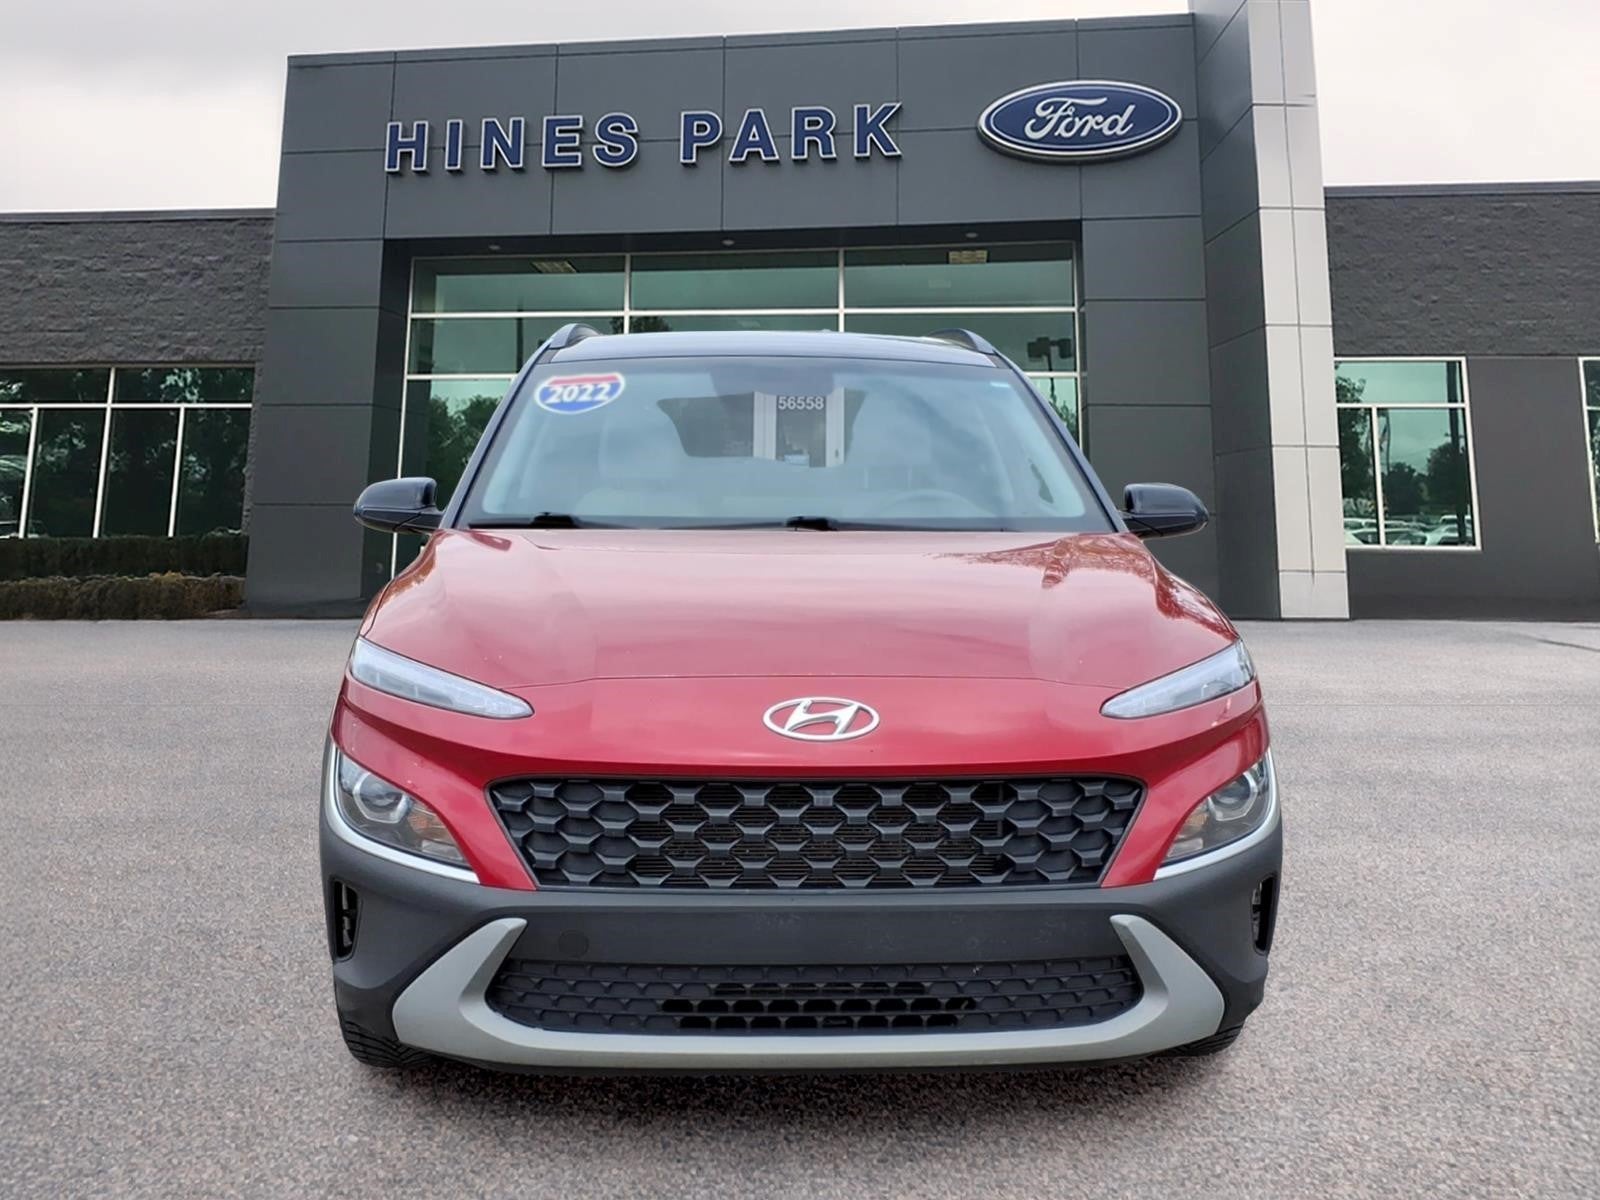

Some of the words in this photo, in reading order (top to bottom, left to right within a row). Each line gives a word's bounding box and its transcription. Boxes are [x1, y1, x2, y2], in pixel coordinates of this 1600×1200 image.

[1024, 97, 1136, 139] Ford
[385, 112, 638, 172] HINES
[680, 102, 902, 163] PARK
[544, 382, 611, 403] 2022
[778, 396, 824, 410] 56558
